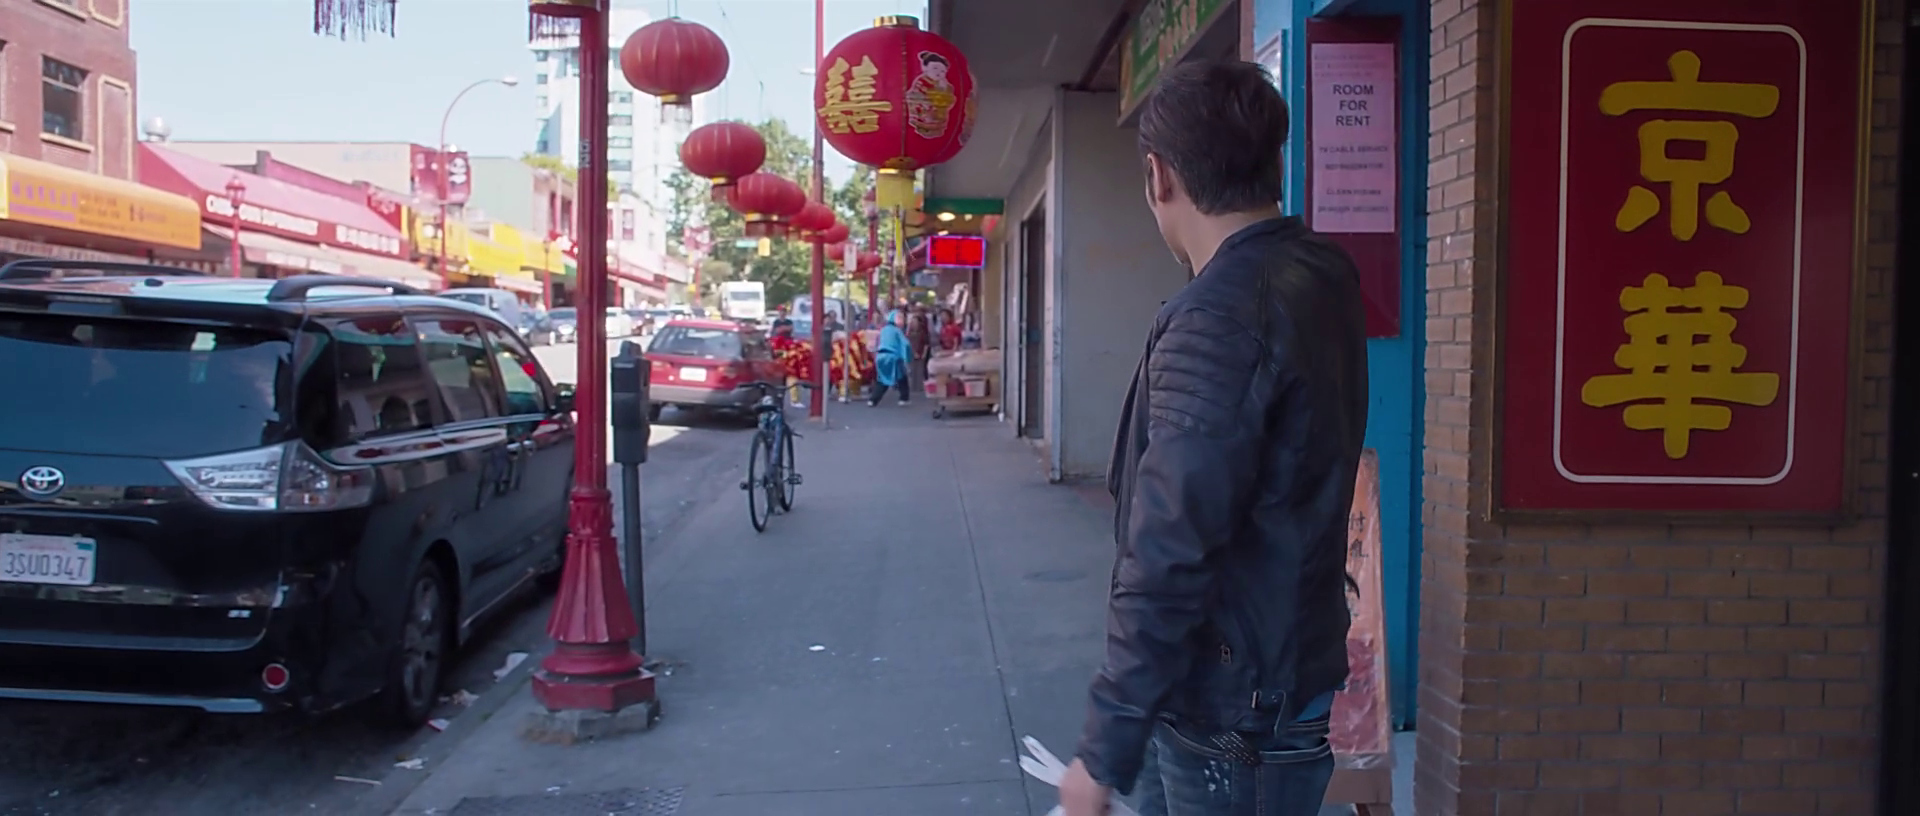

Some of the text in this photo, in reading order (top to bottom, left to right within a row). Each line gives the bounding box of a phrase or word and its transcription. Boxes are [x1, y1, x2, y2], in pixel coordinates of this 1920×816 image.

[1333, 84, 1374, 95] ROOM
[1339, 100, 1368, 111] FOR
[1335, 115, 1371, 126] RENT
[1582, 50, 1780, 459] 京華
